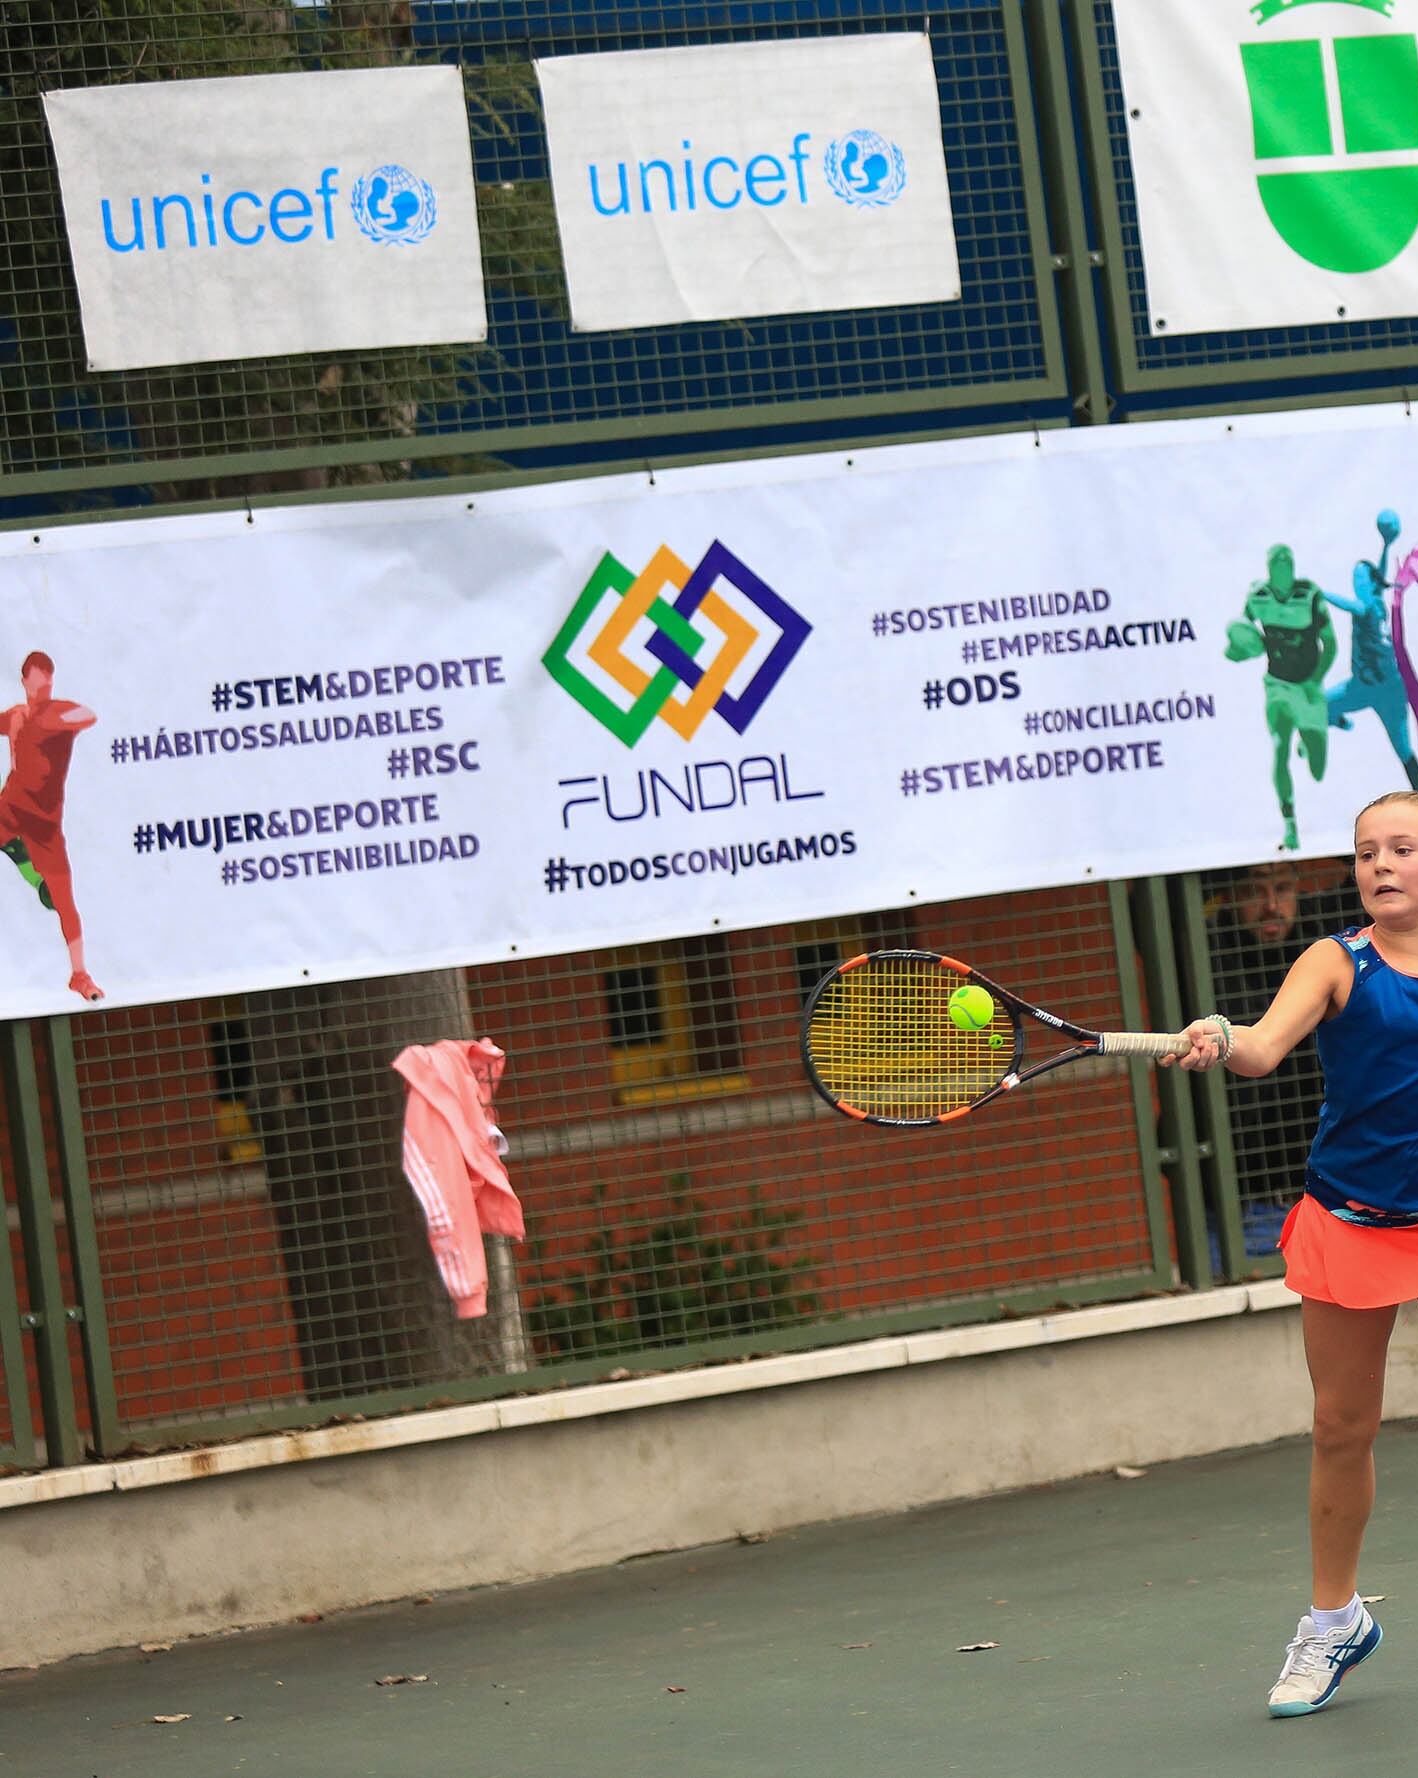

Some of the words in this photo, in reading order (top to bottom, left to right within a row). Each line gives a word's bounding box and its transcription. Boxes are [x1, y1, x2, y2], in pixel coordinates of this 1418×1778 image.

[588, 133, 811, 216] unicef
[102, 168, 339, 252] unicef
[871, 588, 1111, 637] #SOSTENIBILIDAD
[961, 618, 1196, 664] #EMPRESAACTIVA
[211, 655, 505, 712] #STEM&DEPORTE
[922, 671, 1021, 710] #ODS
[111, 706, 443, 763] #HÁBITOSSALUDABLES
[1024, 691, 1216, 735] #CONCILIACIÓN
[387, 741, 480, 778] #RSC
[900, 739, 1164, 798] #STEM&DEPORTE
[558, 753, 825, 829] FUNDAL
[134, 794, 438, 853] #MUJER&DEPORTE
[221, 833, 480, 886] #SOSTENIBILIDAD
[544, 830, 857, 894] #TODOSCONJUGAMOS
